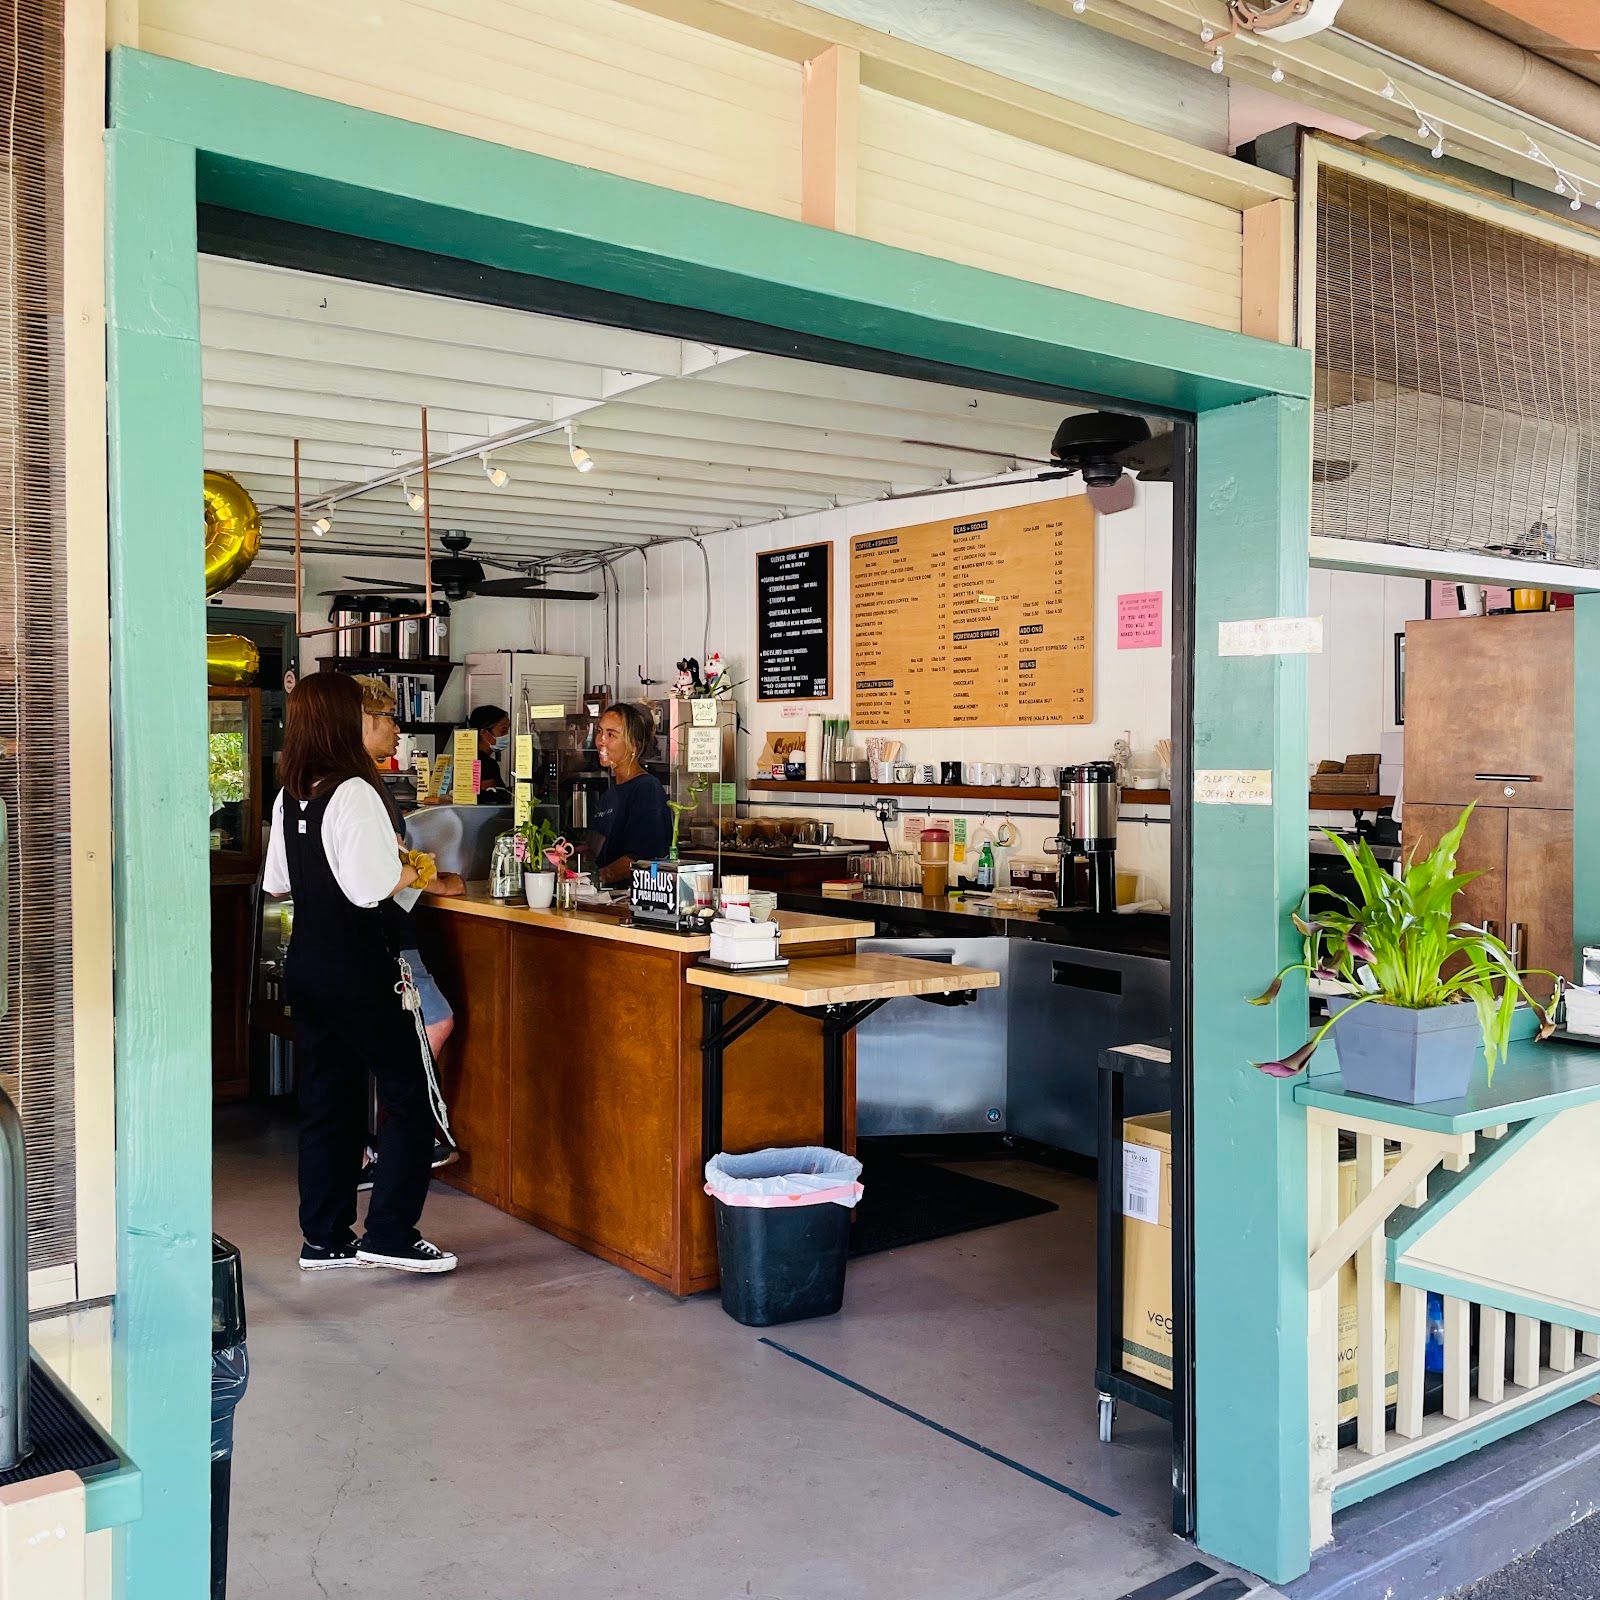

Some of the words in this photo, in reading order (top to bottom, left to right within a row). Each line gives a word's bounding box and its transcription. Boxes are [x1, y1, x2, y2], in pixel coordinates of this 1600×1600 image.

[954, 525, 966, 534] TEAS
[971, 521, 987, 531] SODAS
[954, 631, 980, 640] HOMEMADE
[980, 629, 999, 638] SYRUPS
[633, 870, 673, 892] STRAWS
[638, 890, 651, 901] PUSH
[652, 892, 667, 903] DOWN
